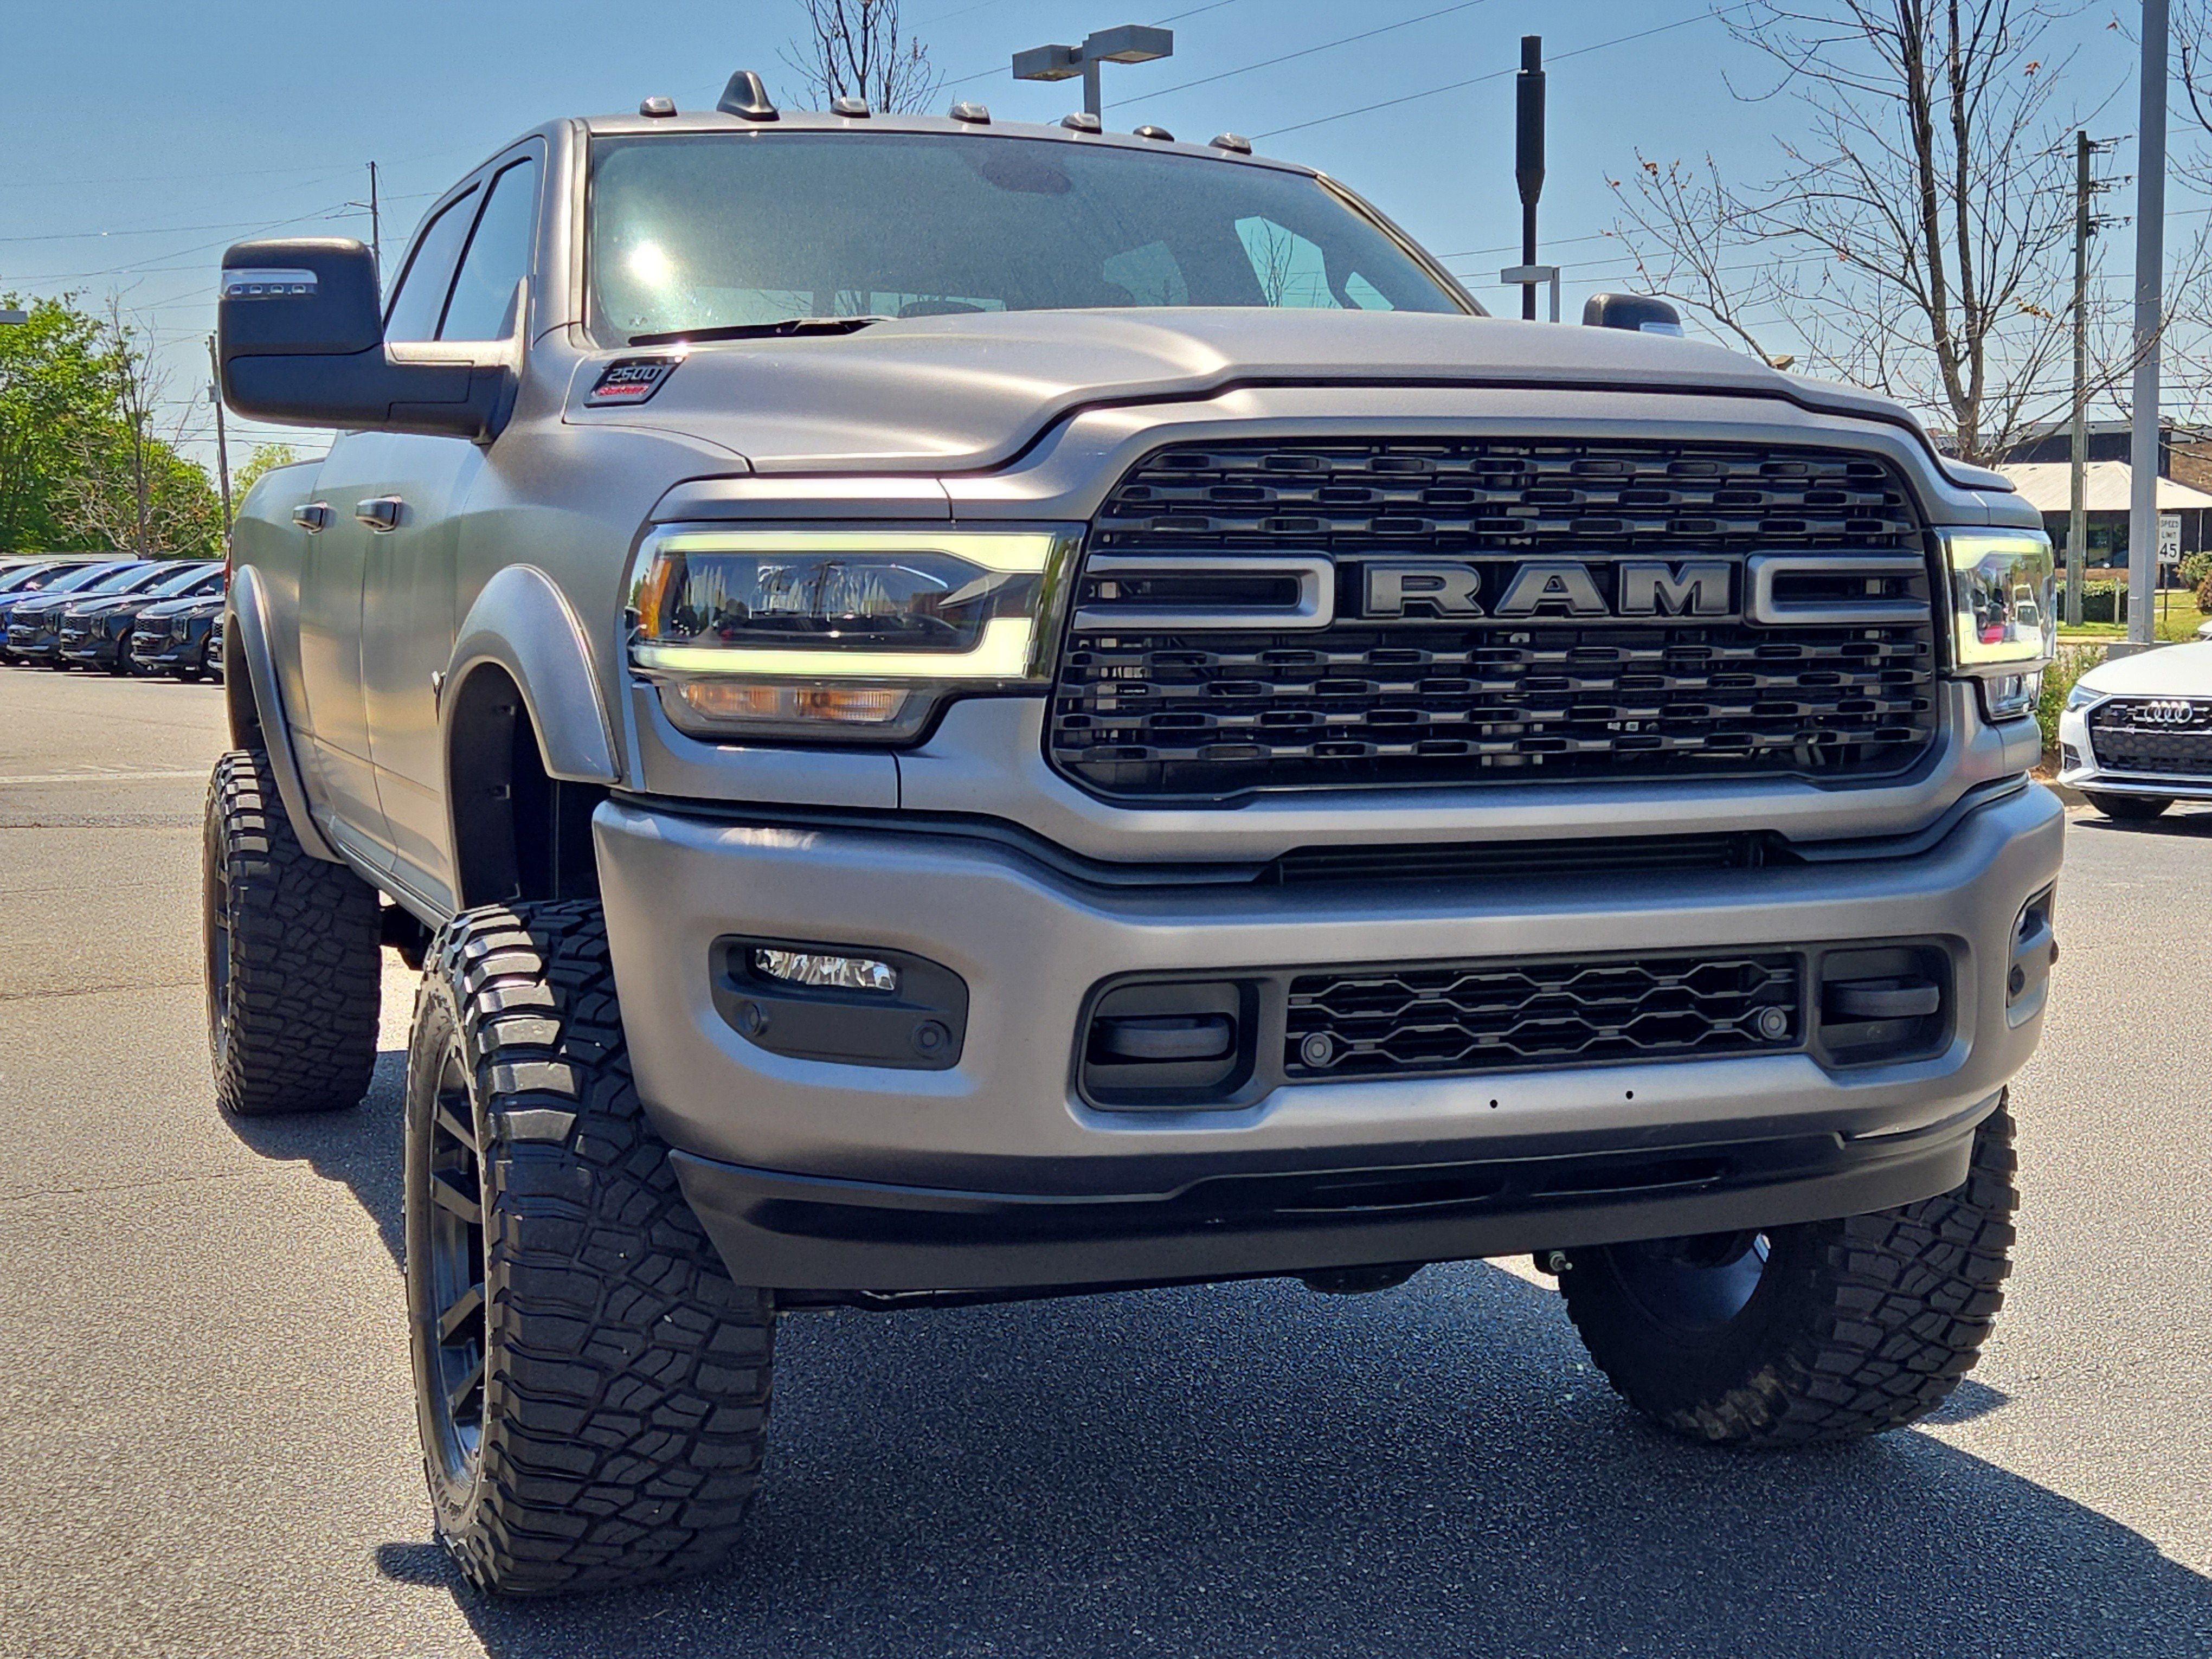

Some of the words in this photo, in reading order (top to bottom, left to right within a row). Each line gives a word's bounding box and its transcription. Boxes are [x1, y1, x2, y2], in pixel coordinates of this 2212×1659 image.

[607, 367, 659, 381] 2500
[2160, 520, 2179, 528] SPEED
[2159, 543, 2177, 558] 45
[1362, 562, 1732, 616] RAM
